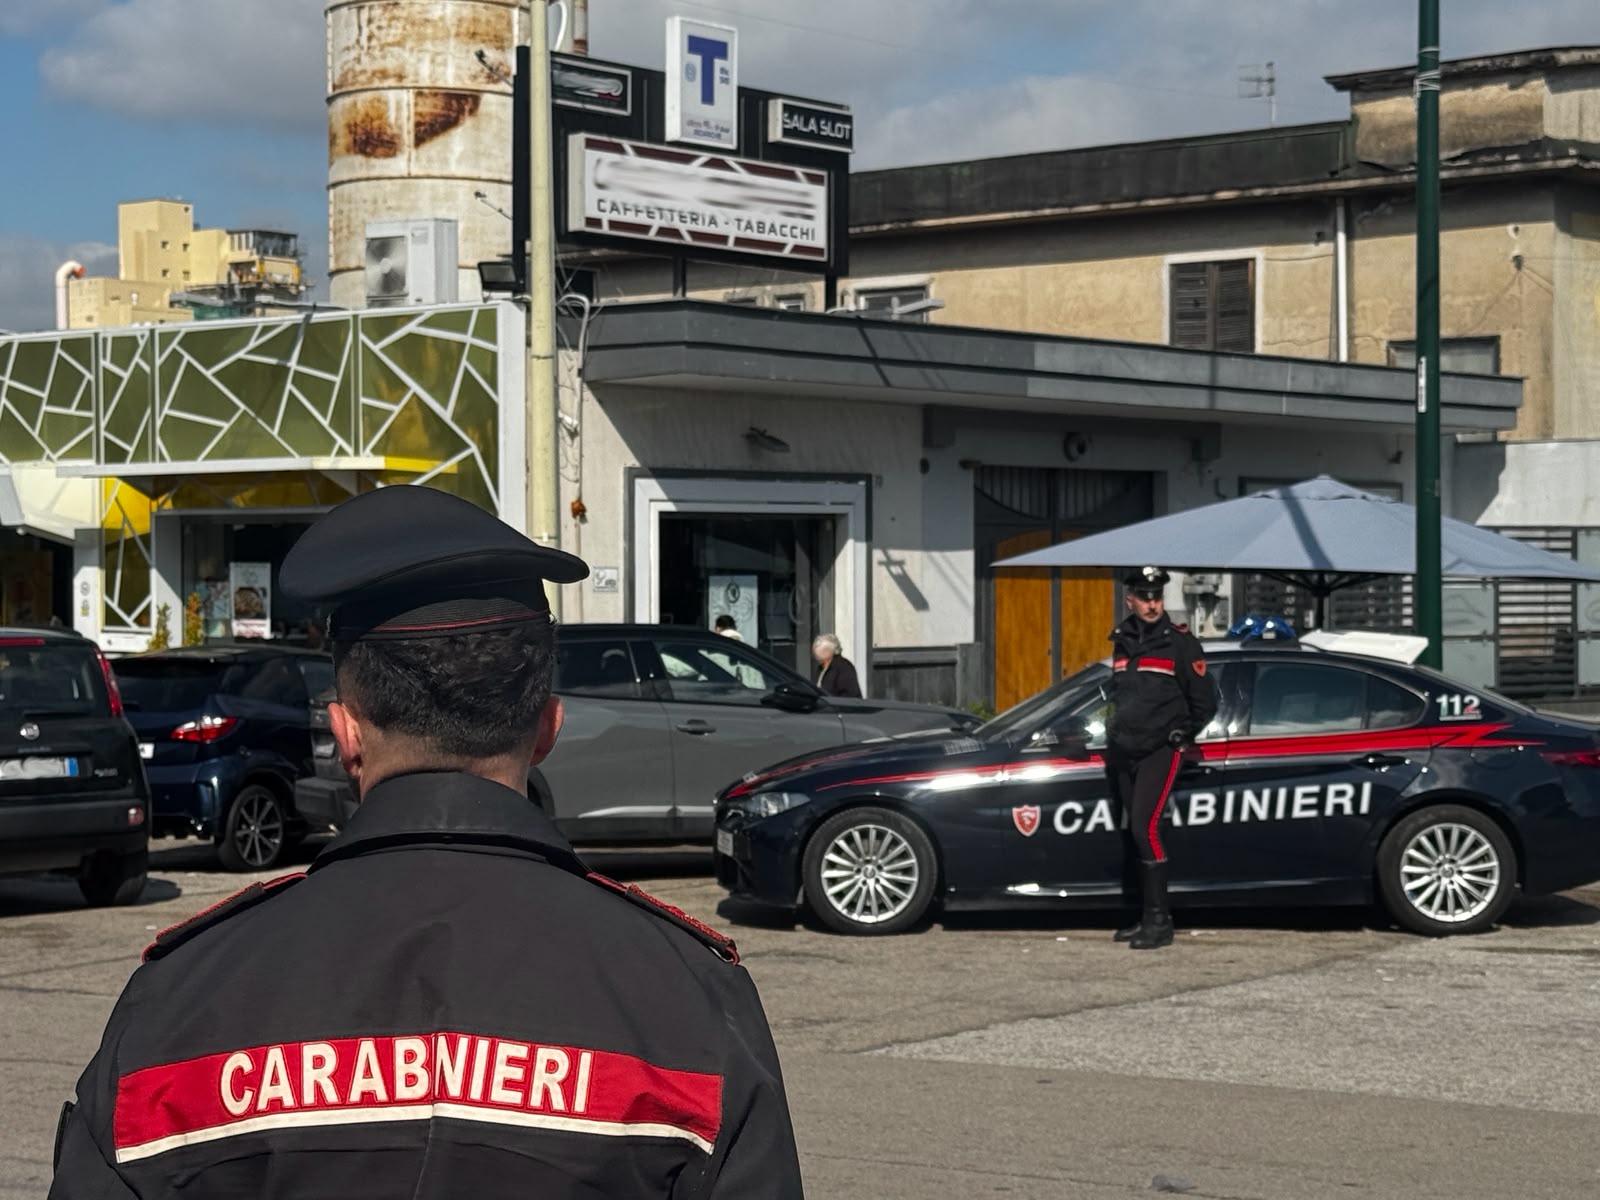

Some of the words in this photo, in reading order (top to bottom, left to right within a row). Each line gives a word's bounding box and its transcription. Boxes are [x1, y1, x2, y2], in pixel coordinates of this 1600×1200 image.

[687, 34, 729, 107] T
[783, 112, 818, 134] SALA
[819, 119, 851, 140] SLOT
[596, 198, 719, 229] CAFFETTERIA
[735, 217, 816, 242] TABACCHI
[1435, 693, 1481, 717] 112
[1053, 781, 1373, 835] CAABINIERI
[220, 1034, 592, 1115] CARABNIERI
